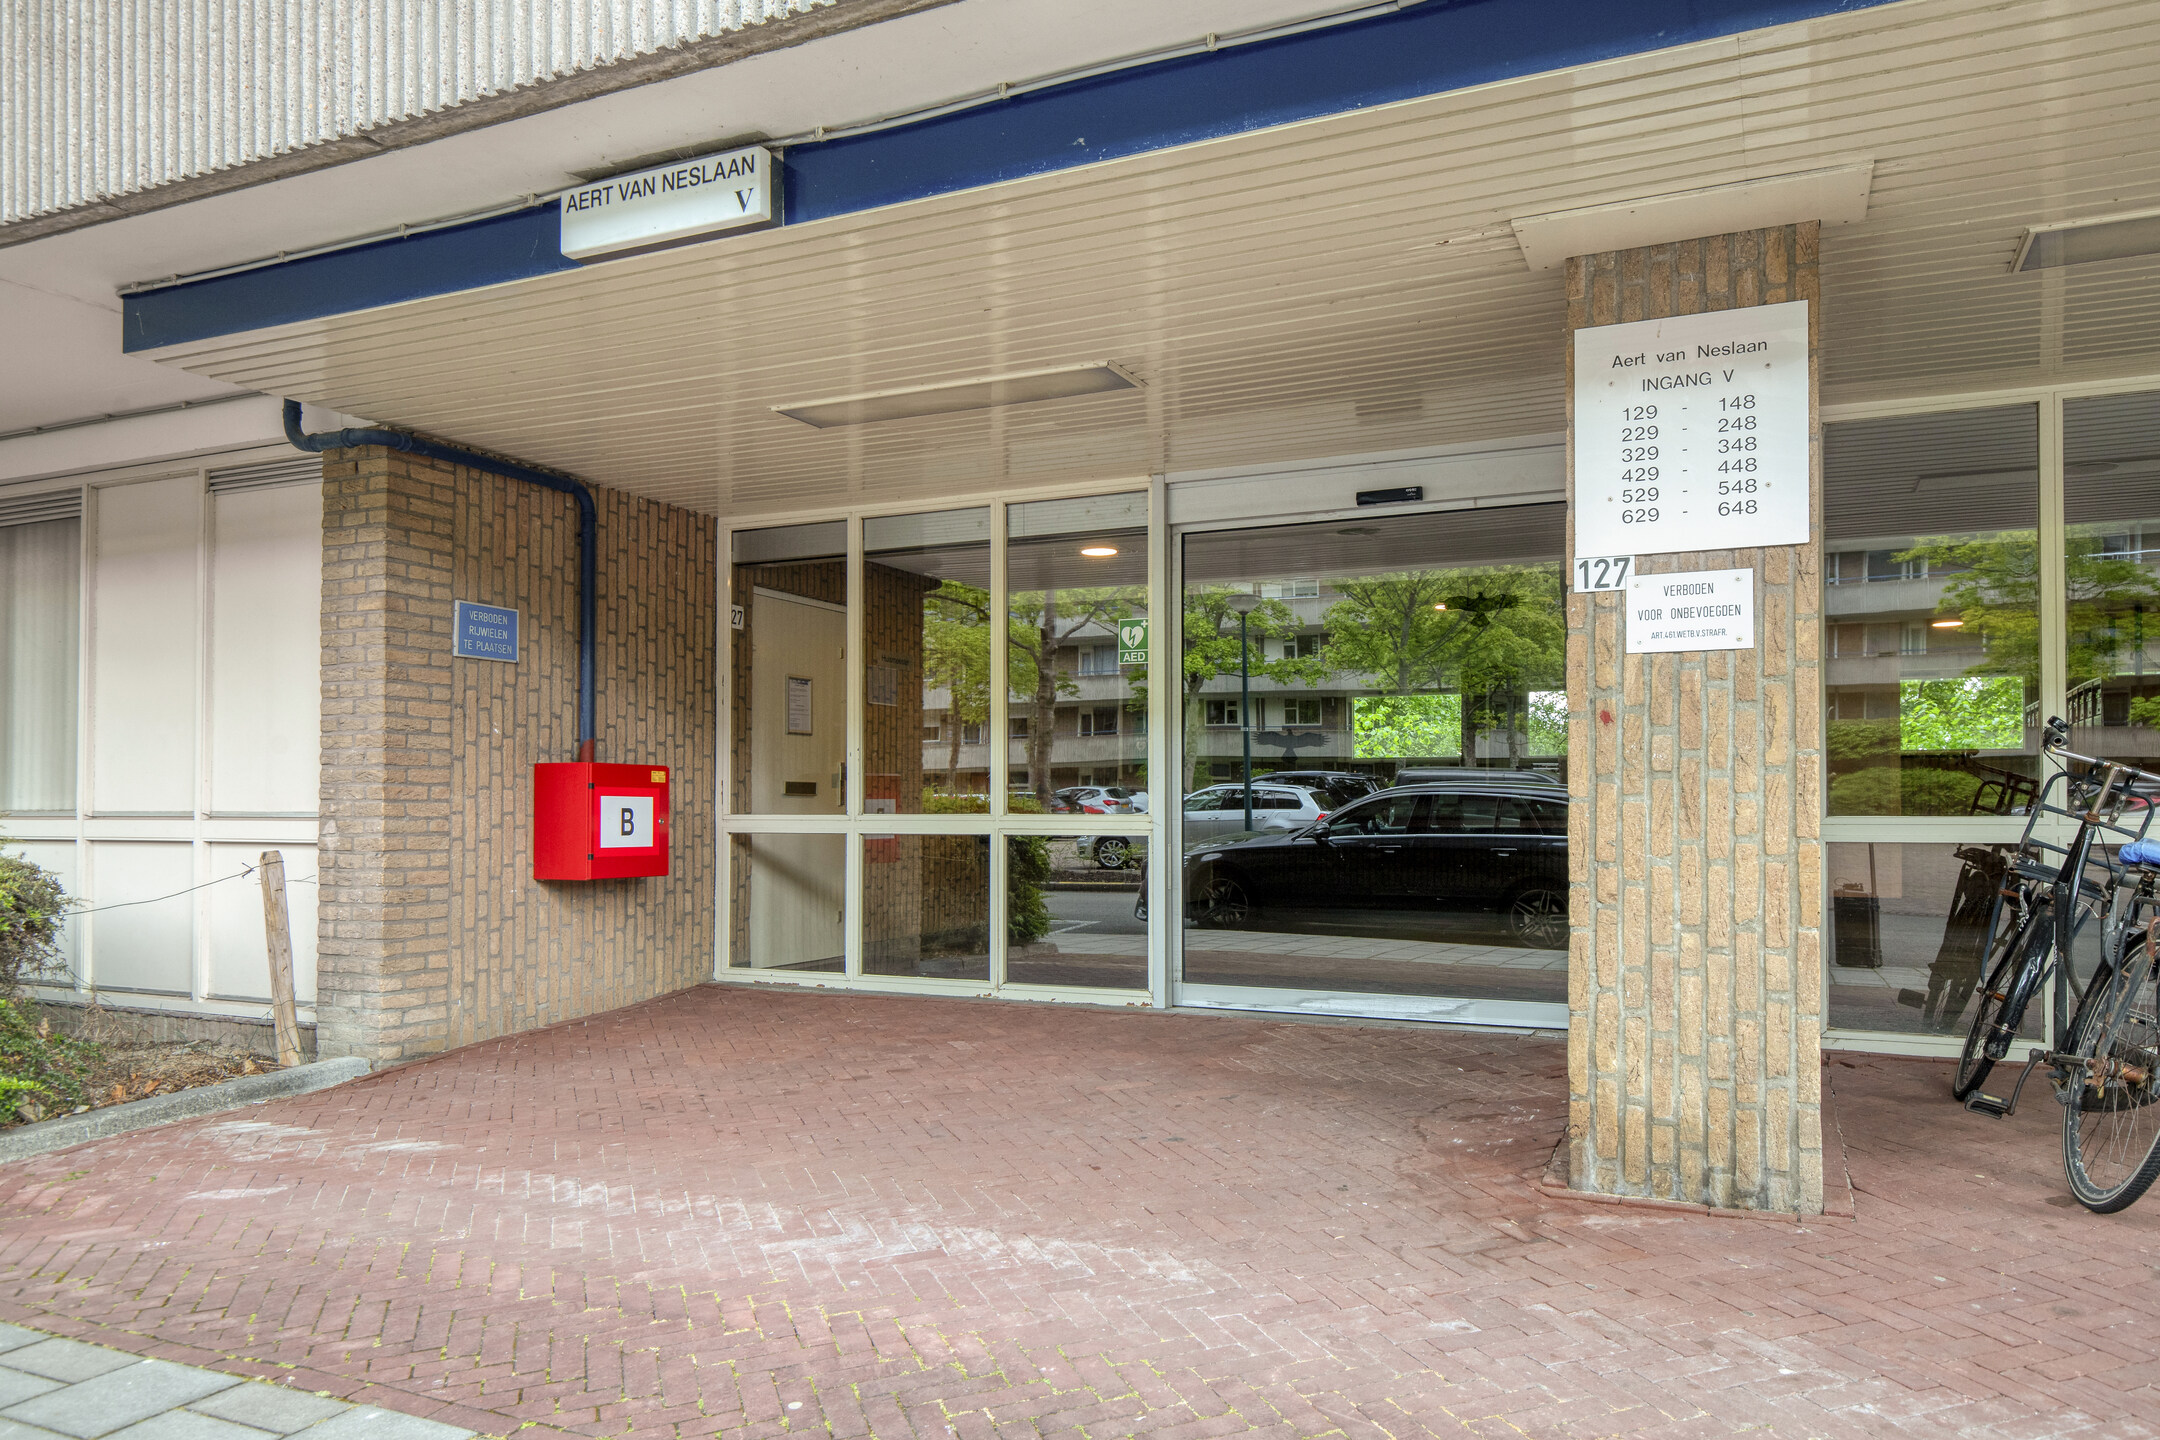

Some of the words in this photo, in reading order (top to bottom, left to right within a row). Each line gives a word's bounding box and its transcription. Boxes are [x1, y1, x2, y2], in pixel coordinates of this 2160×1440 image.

[566, 186, 613, 213] AERT
[618, 176, 655, 201] VAN
[662, 154, 755, 192] NESLAAN
[734, 187, 754, 213] V
[1612, 352, 1646, 369] Aert
[1656, 350, 1686, 363] van
[1697, 340, 1768, 359] Neslaan
[1642, 372, 1712, 392] INGANG
[1723, 369, 1735, 383] V
[1622, 405, 1658, 421] 129
[1719, 394, 1755, 412] 148
[1622, 426, 1659, 442] 229
[1718, 416, 1757, 433] 248
[1622, 446, 1659, 462] 329
[1718, 436, 1757, 454] 348
[1622, 467, 1659, 483] 429
[1718, 458, 1757, 474] 448
[1622, 487, 1659, 503] 529
[1718, 479, 1757, 496] 548
[1622, 508, 1660, 524] 629
[1718, 500, 1758, 516] 648
[1578, 557, 1631, 589] 127
[1663, 583, 1714, 597] VERBODEN
[469, 610, 508, 625] VERBODEN
[1638, 609, 1662, 621] VOOR
[1670, 604, 1741, 620] ONBEVOEGDEN
[469, 625, 508, 639] RIJWIELEN
[464, 639, 473, 650] TE
[476, 640, 512, 654] PLAATSEN
[1123, 652, 1146, 662] AED
[621, 807, 635, 836] B
